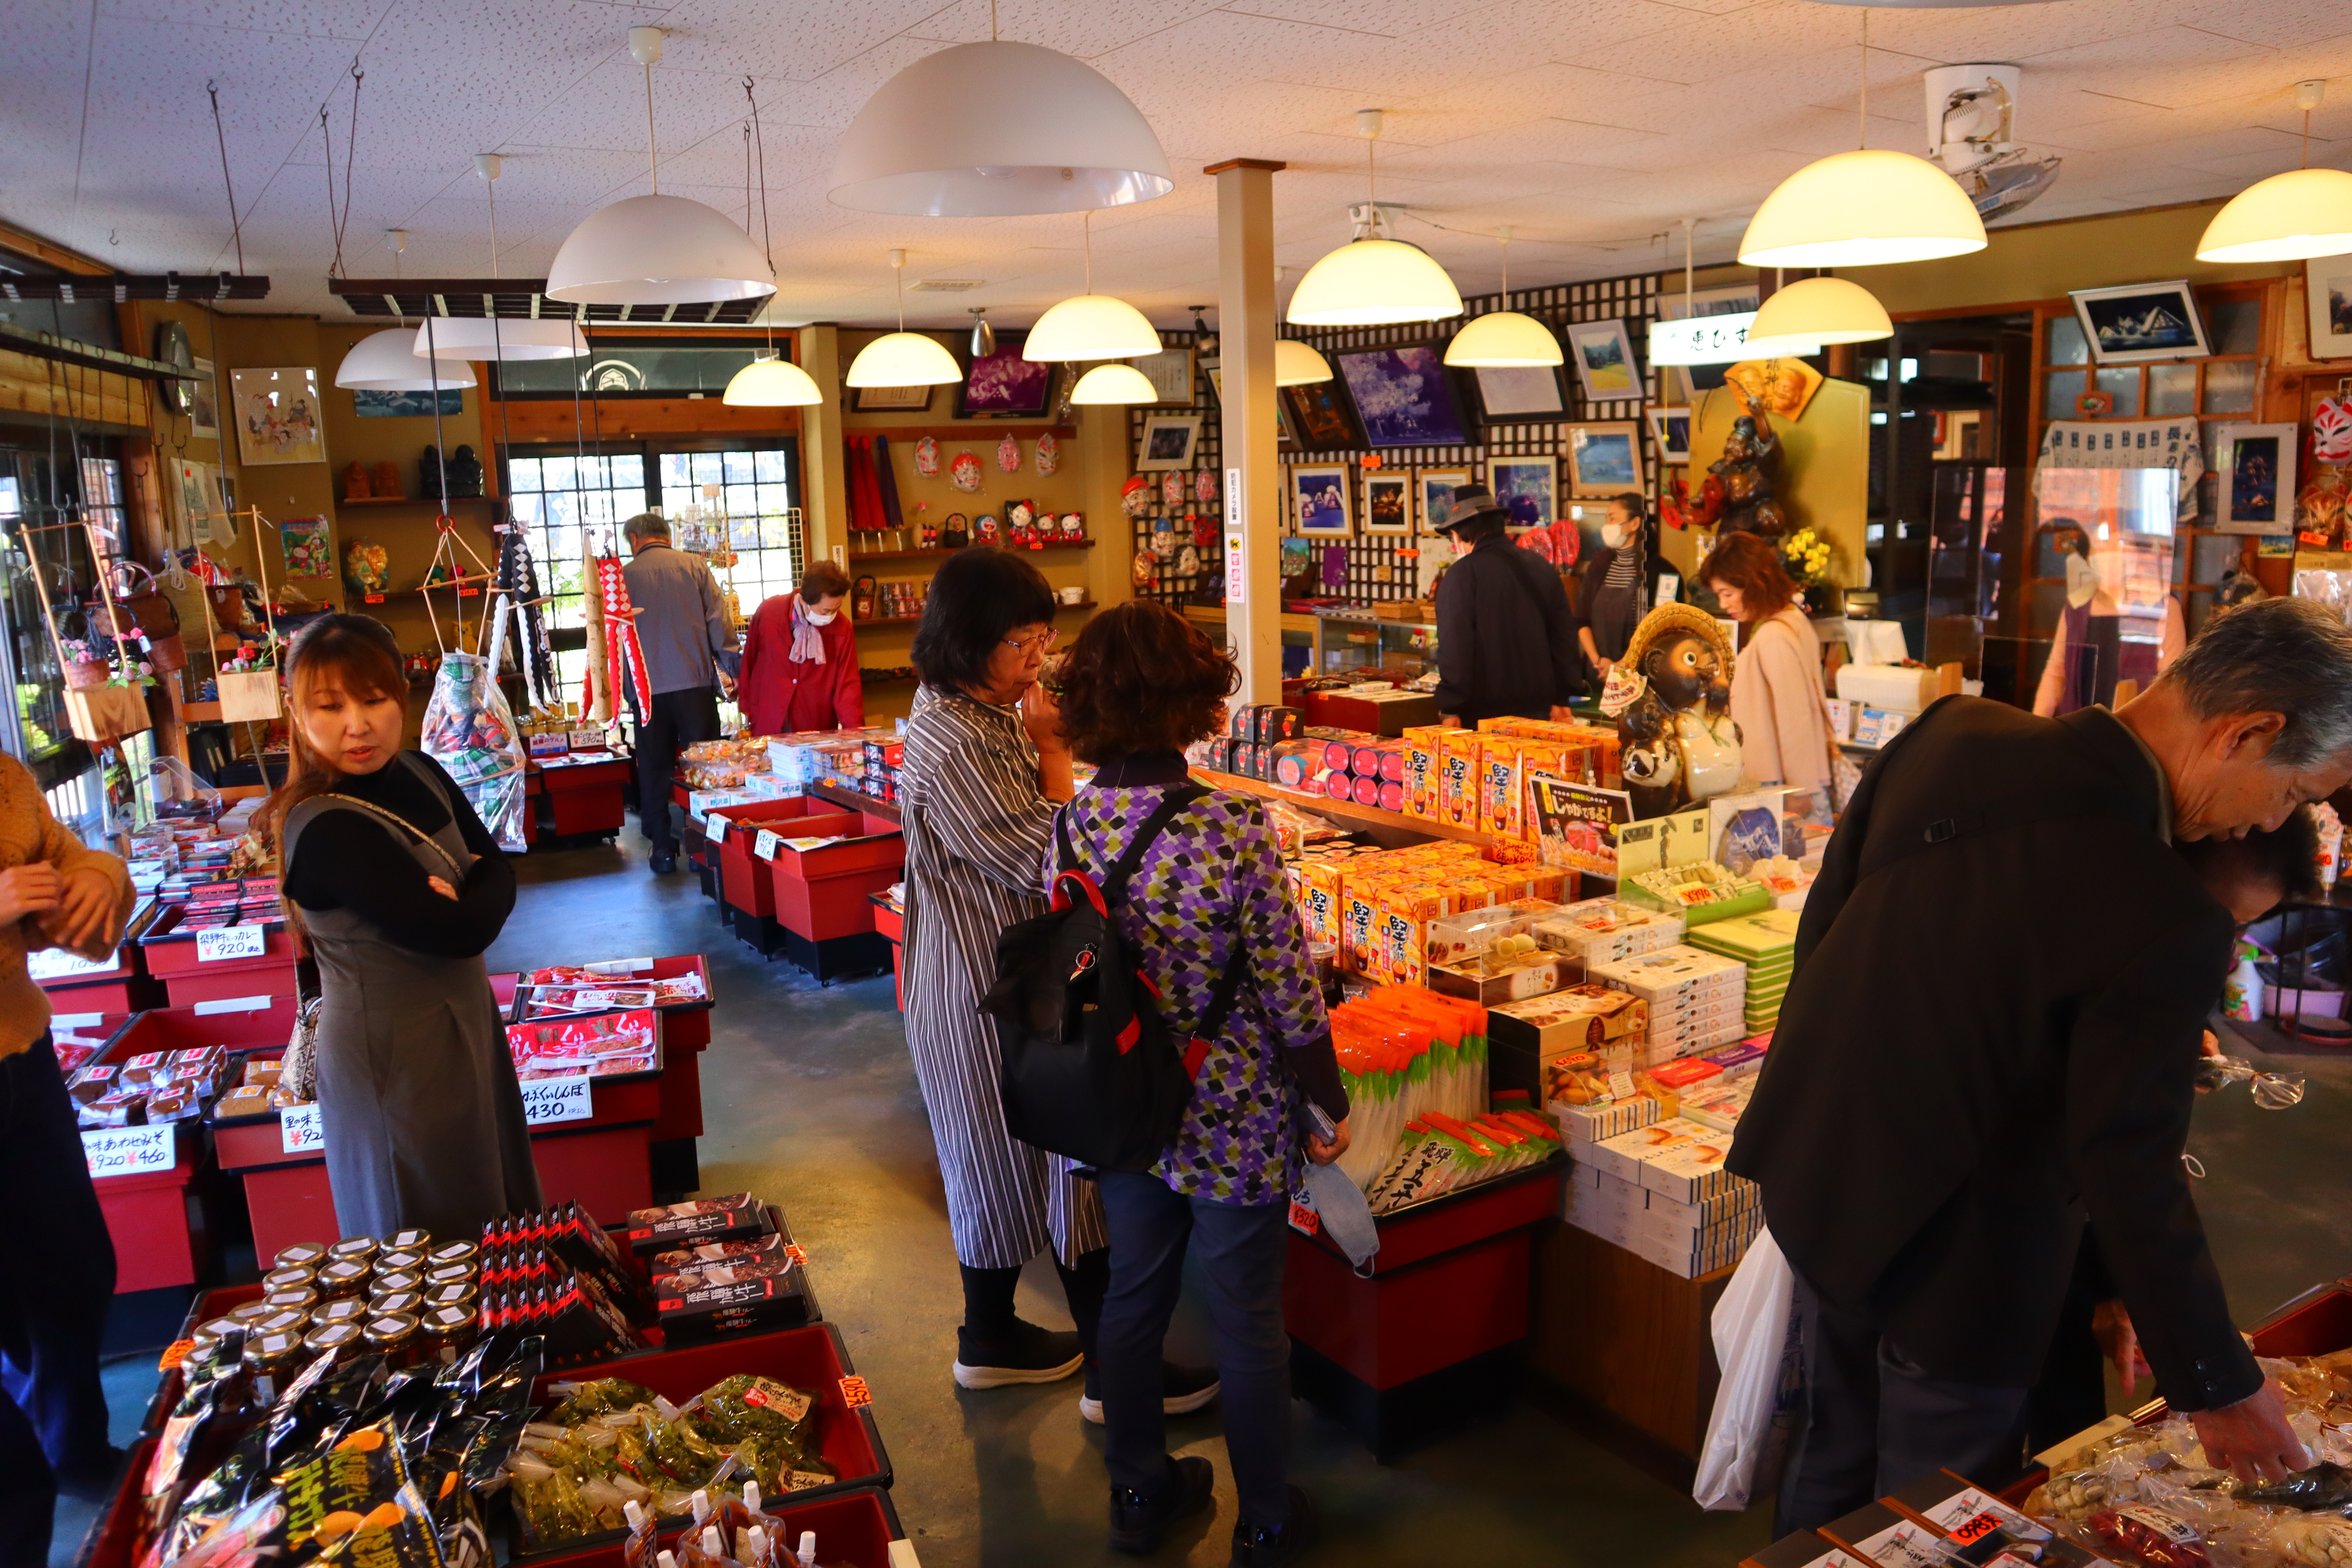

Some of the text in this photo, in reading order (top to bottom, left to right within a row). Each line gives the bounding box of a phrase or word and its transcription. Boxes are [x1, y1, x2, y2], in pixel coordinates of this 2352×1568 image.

[1683, 889, 1711, 903] ¥970
[526, 1102, 564, 1119] 430
[290, 1128, 322, 1146] ¥92
[686, 1284, 757, 1304] 飛騨牛
[843, 1379, 871, 1407] ¥590
[1957, 1514, 2004, 1539] ¥860
